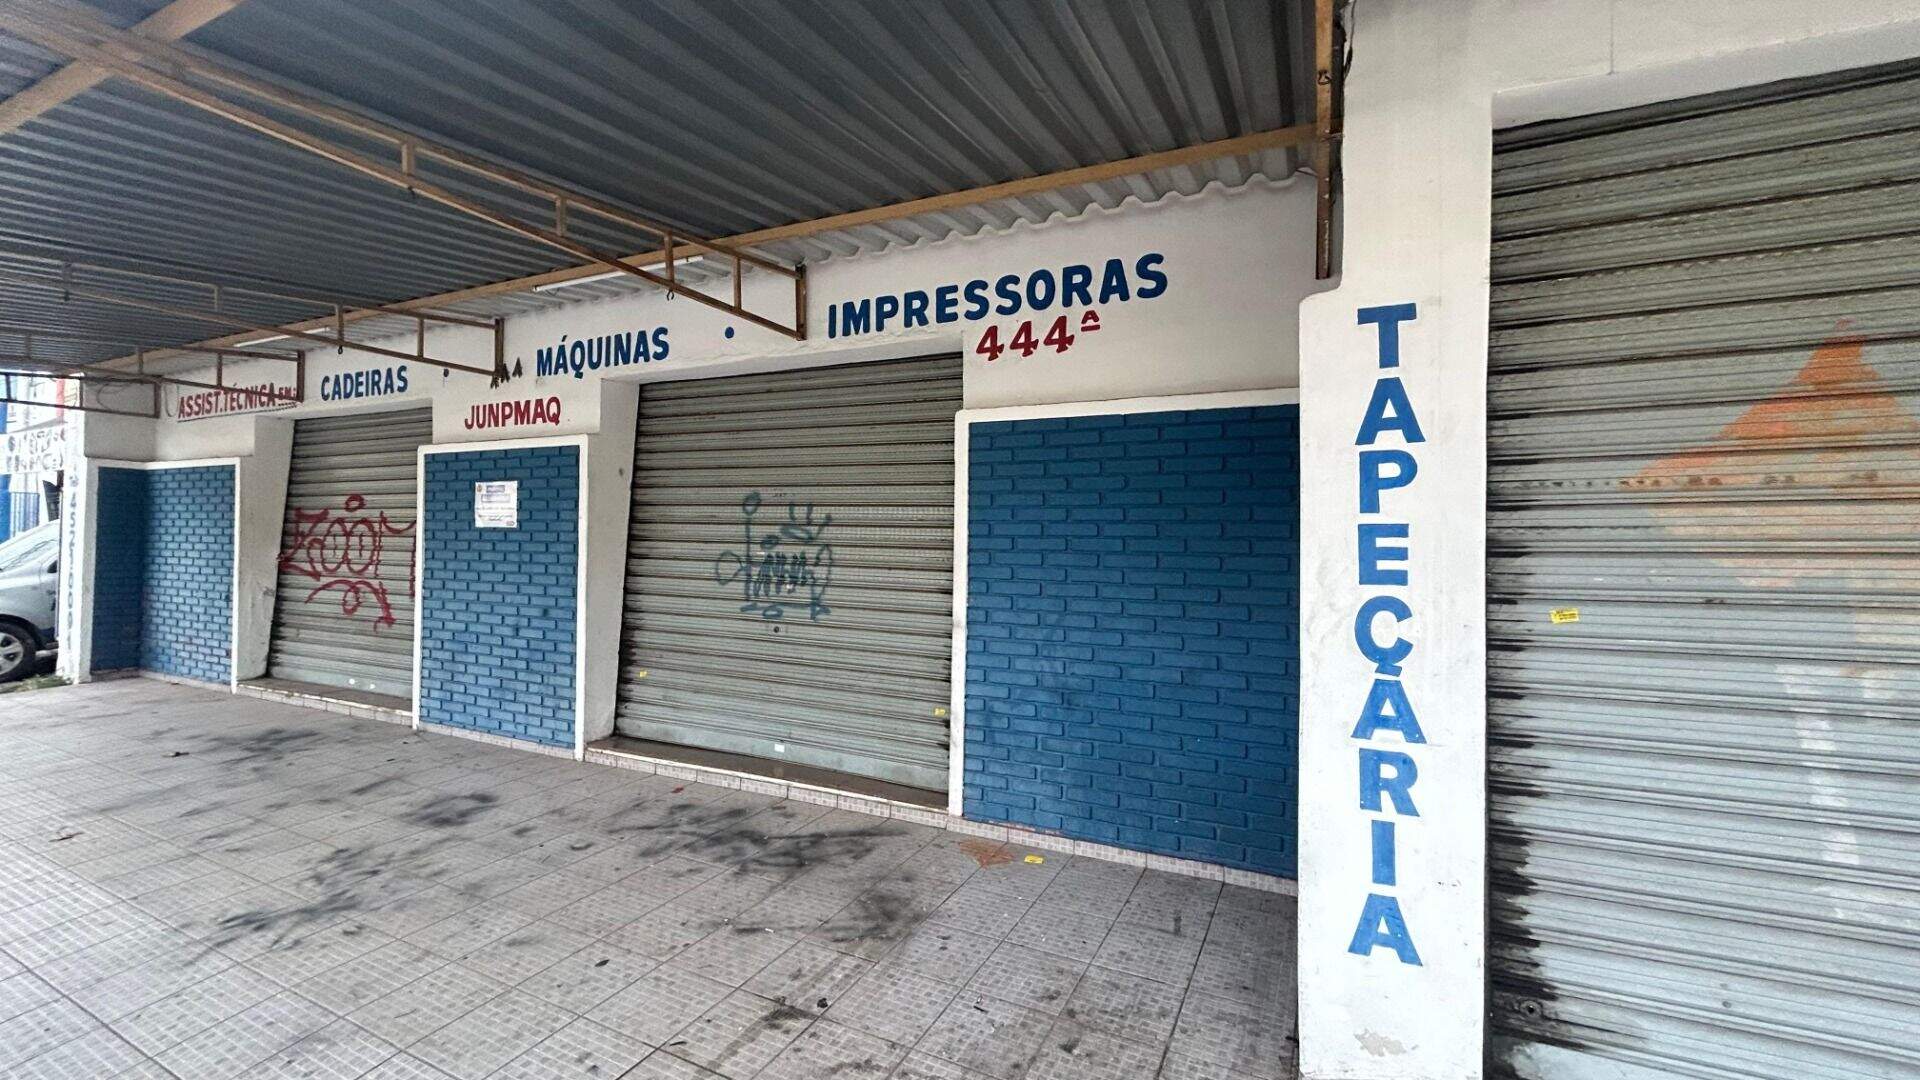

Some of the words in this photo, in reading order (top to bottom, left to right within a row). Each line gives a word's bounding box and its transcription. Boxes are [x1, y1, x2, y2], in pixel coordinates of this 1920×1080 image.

[828, 253, 1168, 338] IMPRESSORAS
[536, 326, 671, 379] MÁQUINAS
[321, 365, 408, 401] CADEIRAS
[464, 397, 561, 429] JUNPMAQ
[1347, 302, 1427, 967] TAPEÇARIA
